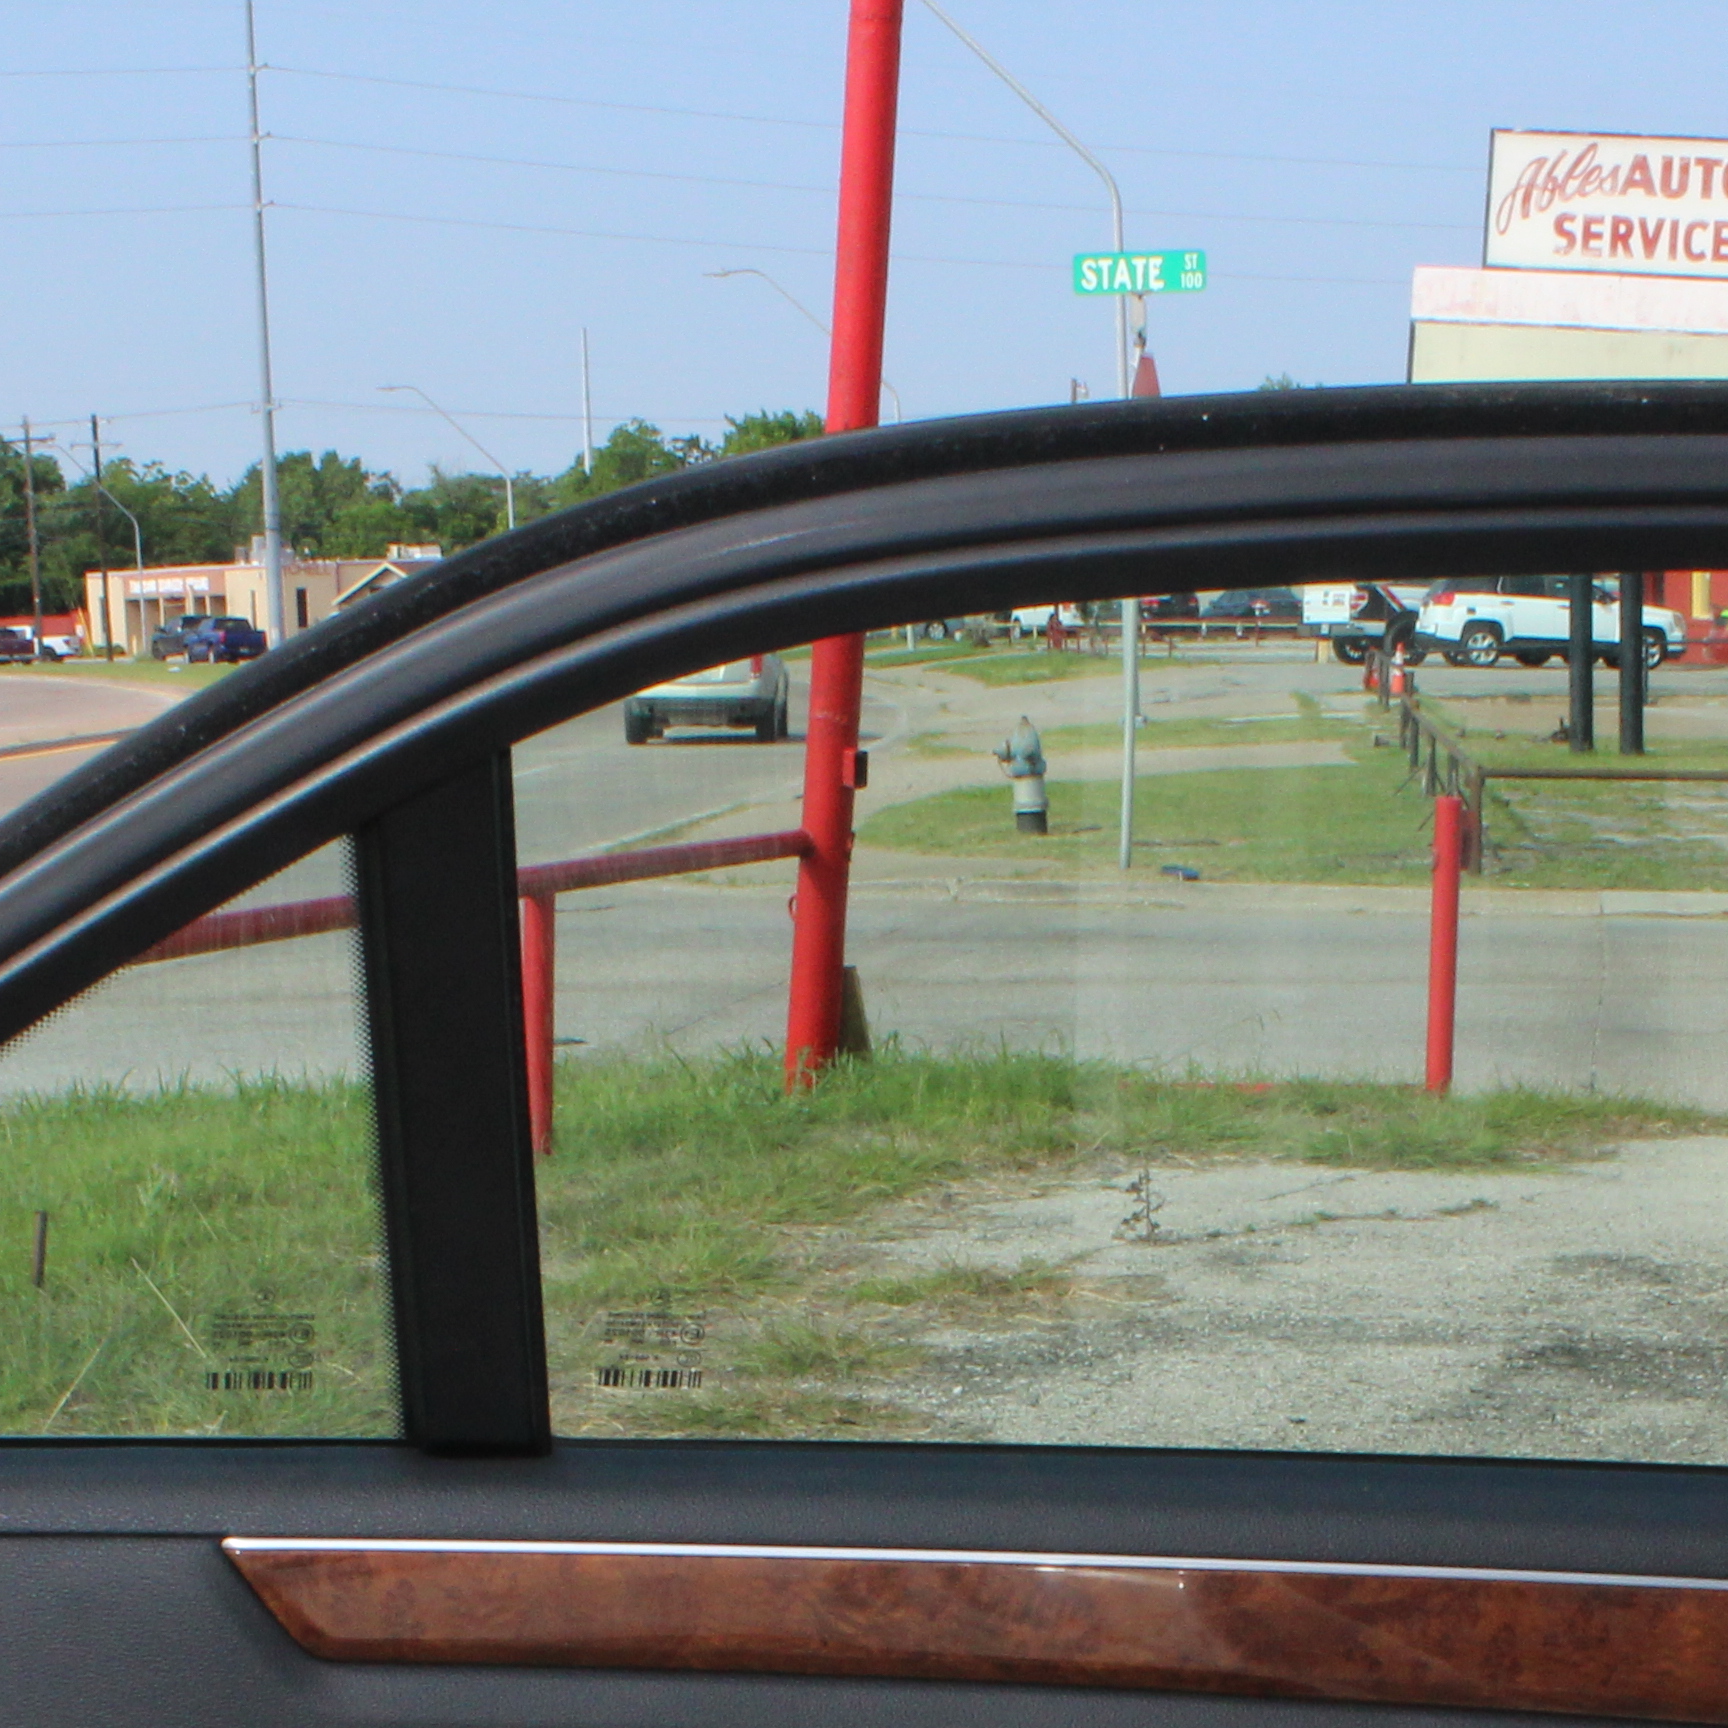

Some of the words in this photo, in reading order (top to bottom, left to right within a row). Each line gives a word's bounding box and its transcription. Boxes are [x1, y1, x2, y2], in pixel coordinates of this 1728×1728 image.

[1495, 143, 1621, 235] Ables
[1081, 256, 1165, 291] STATE
[1184, 252, 1198, 270] ST
[1181, 272, 1203, 288] 100
